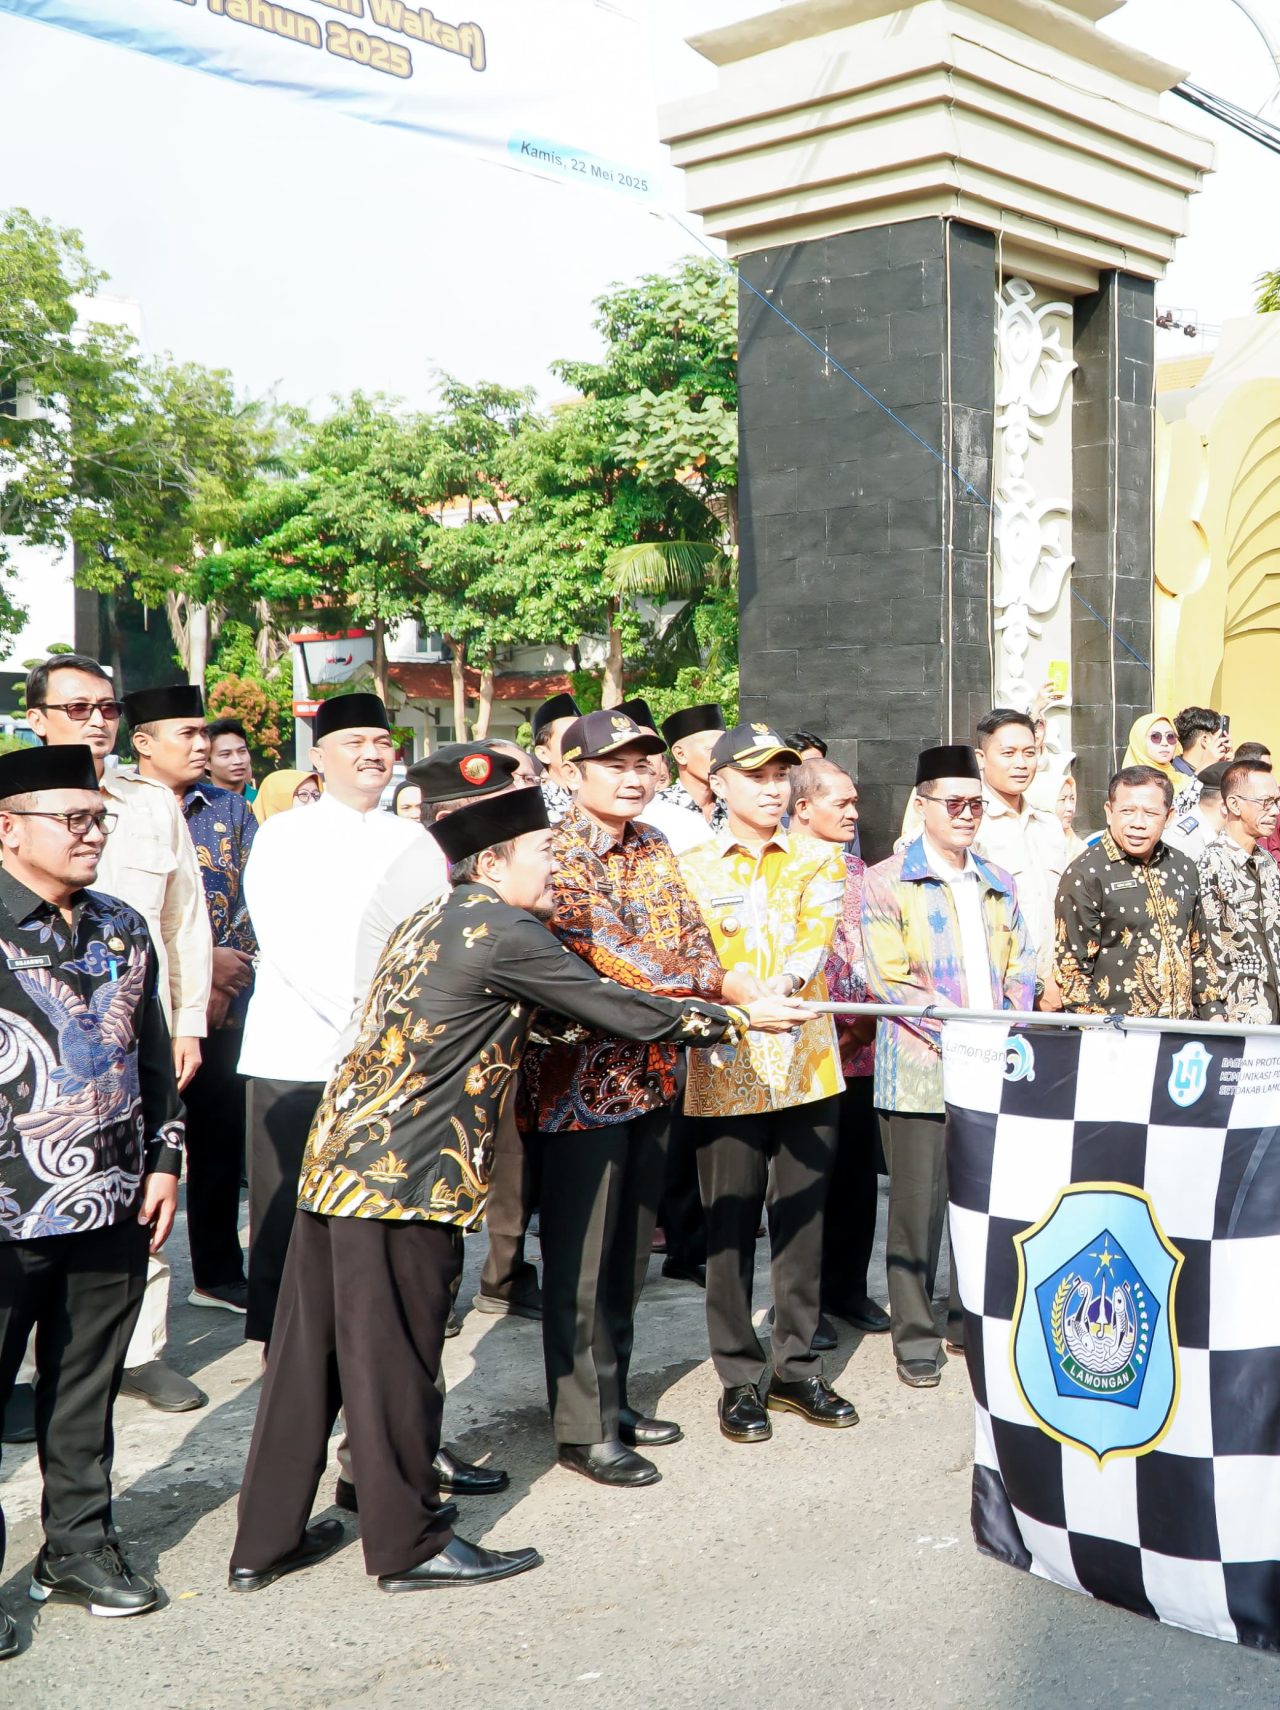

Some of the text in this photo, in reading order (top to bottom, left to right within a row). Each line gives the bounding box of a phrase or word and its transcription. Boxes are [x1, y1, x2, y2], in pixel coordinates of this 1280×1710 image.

[325, 20, 413, 79] 2025
[520, 140, 649, 192] Kamis, 22 Mei 2025
[944, 1039, 1007, 1064] Lamongan
[1220, 1070, 1271, 1082] KOMUNIKASI
[1069, 1363, 1130, 1389] LAMONGAN
